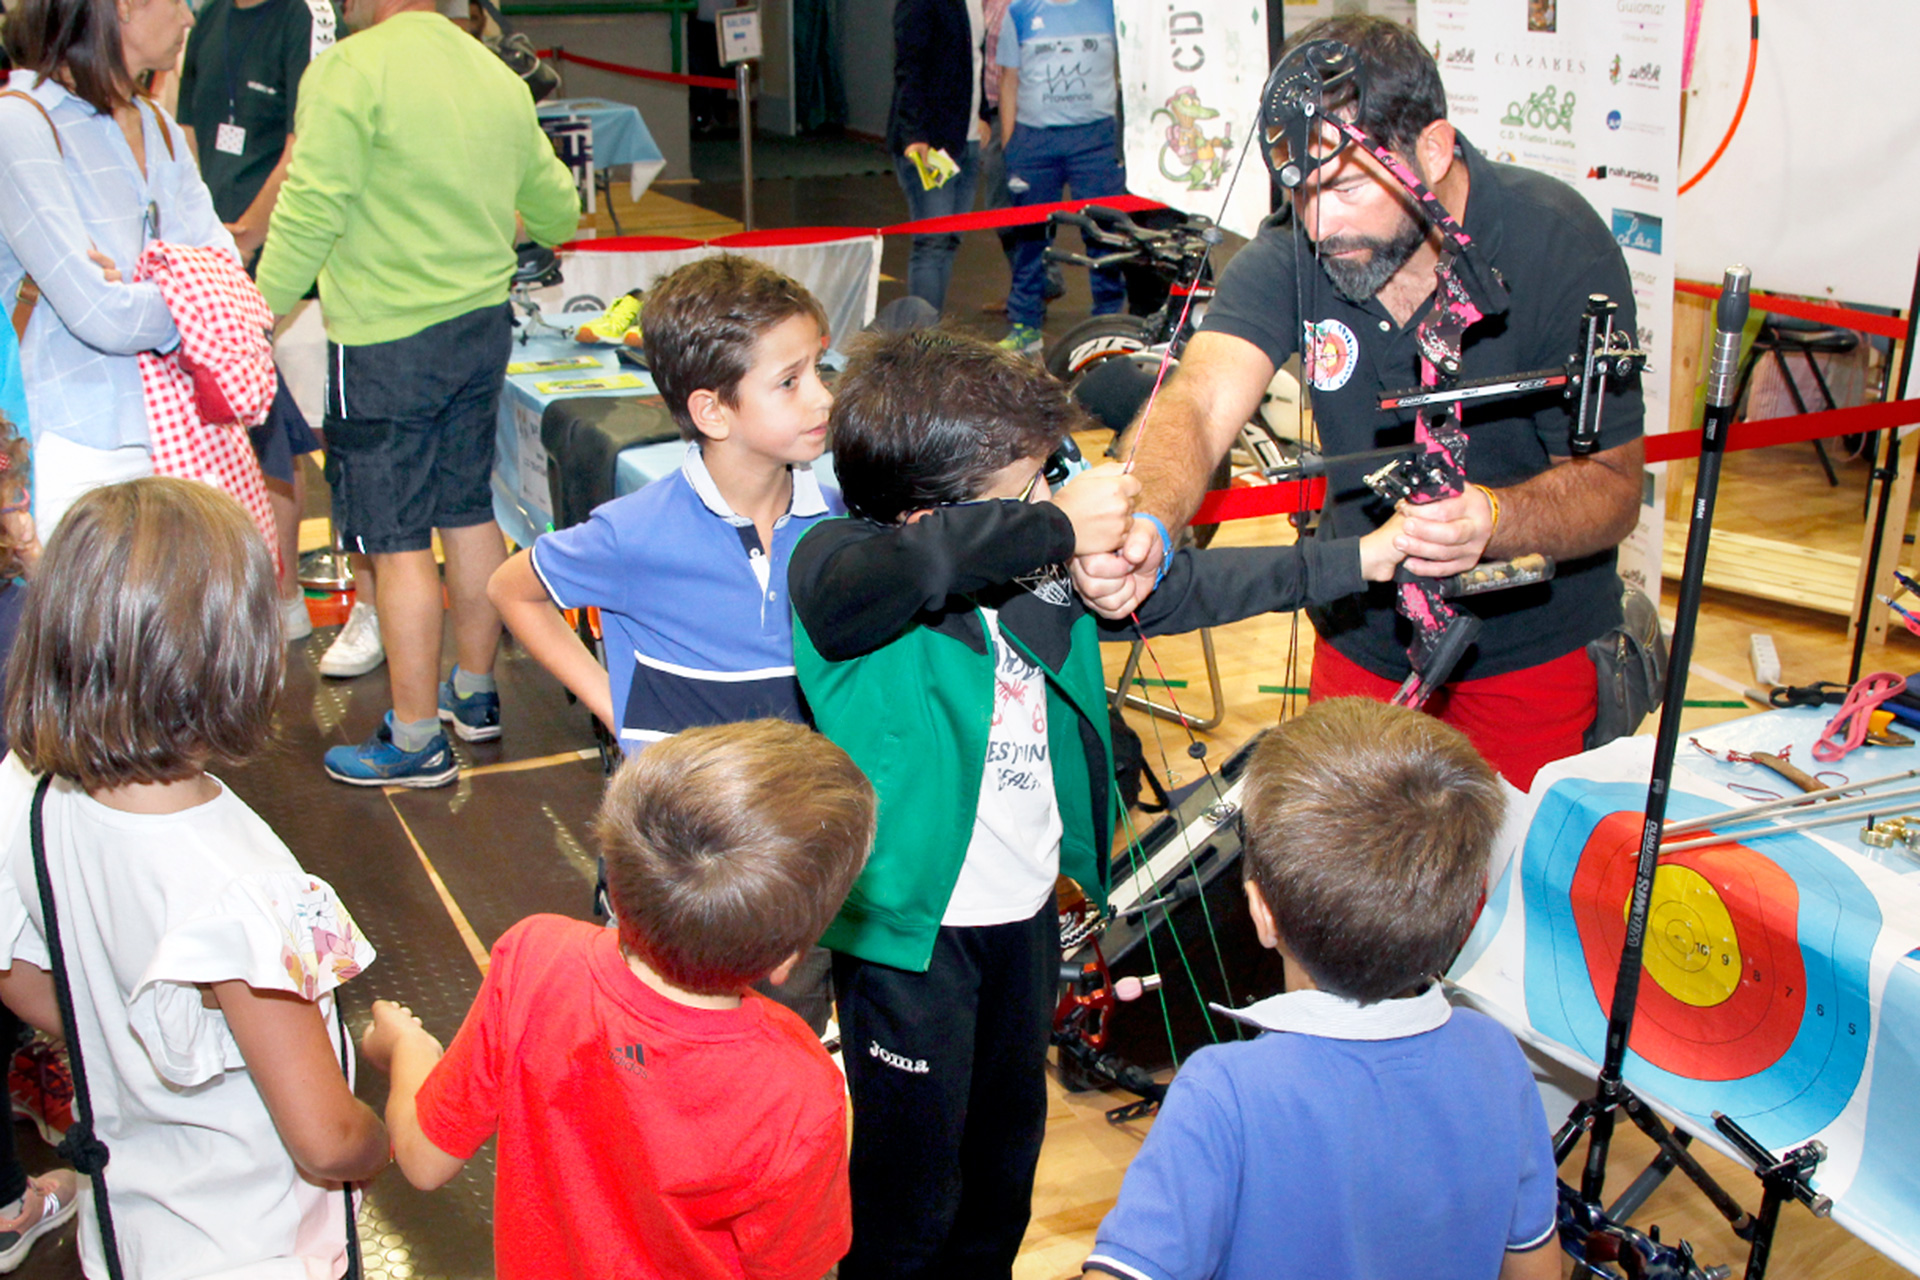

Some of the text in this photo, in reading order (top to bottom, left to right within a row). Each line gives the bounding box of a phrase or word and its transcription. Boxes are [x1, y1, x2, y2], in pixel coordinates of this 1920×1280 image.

[1608, 166, 1660, 184] naturpiedra
[1721, 953, 1730, 967] 9
[1752, 969, 1762, 983] 8
[1785, 986, 1794, 999] 7
[1816, 1003, 1825, 1017] 6
[1848, 1022, 1857, 1036] 5
[607, 1050, 648, 1080] adidas
[868, 1040, 930, 1074] Joma
